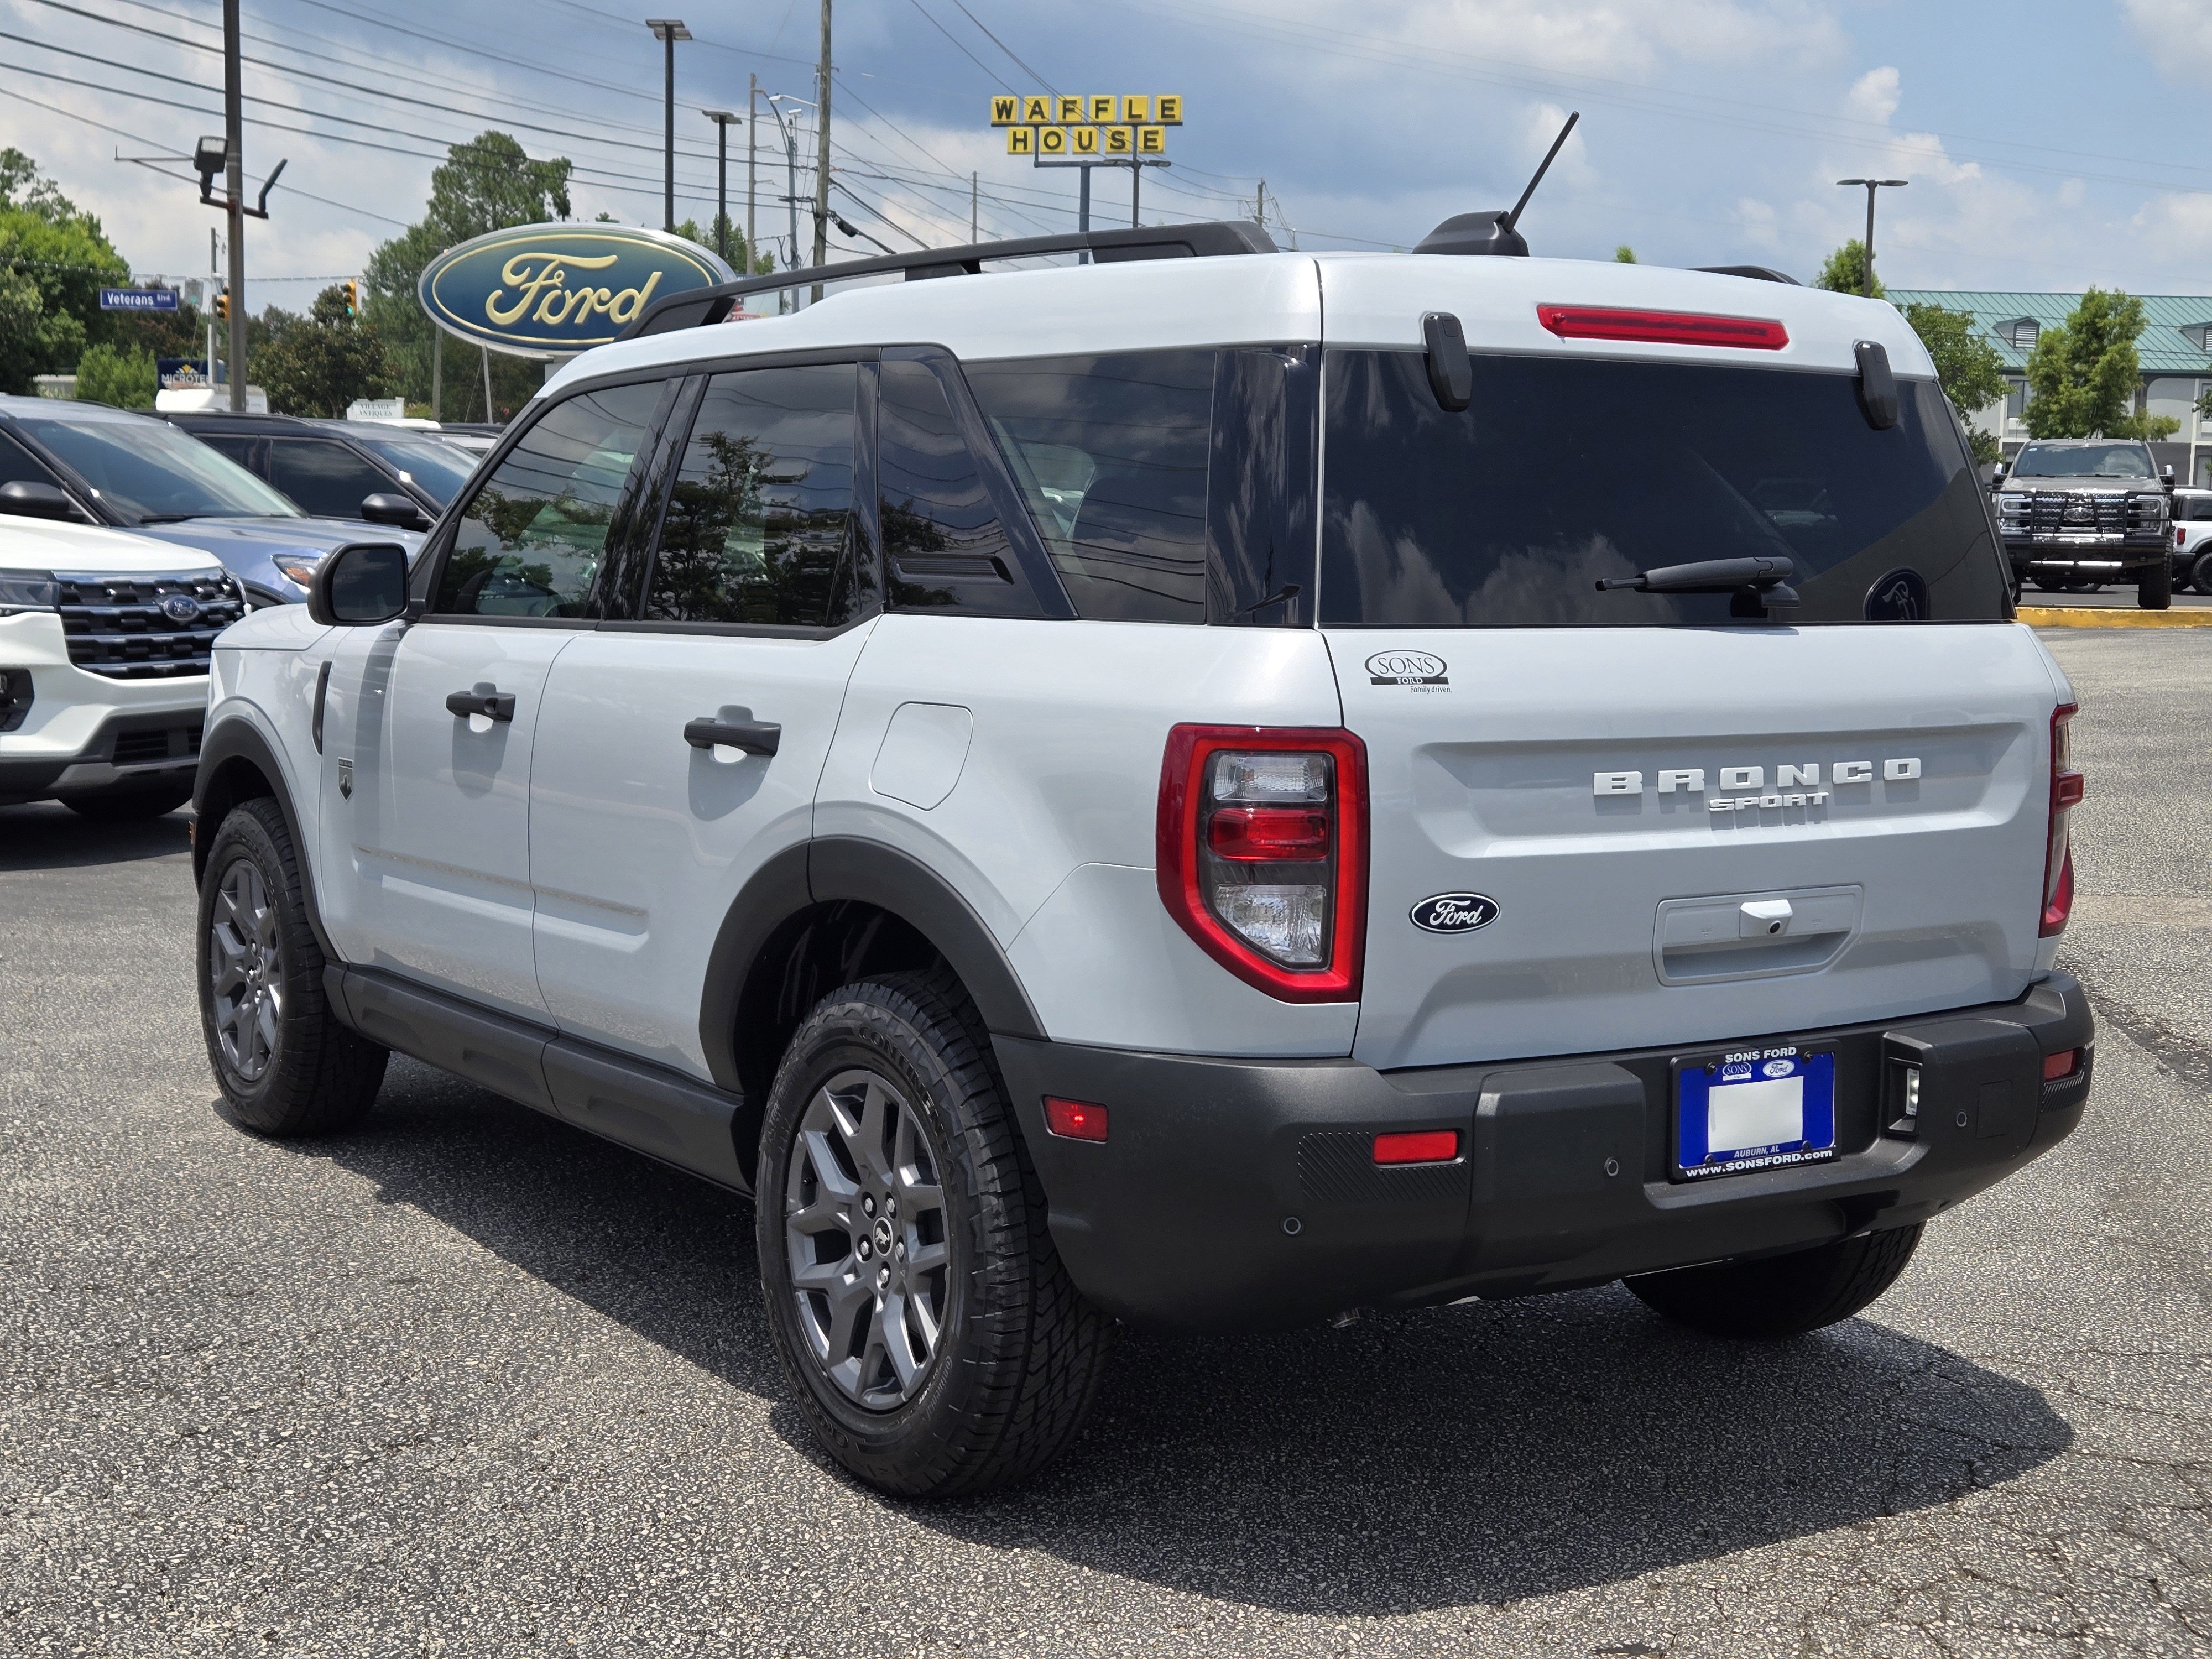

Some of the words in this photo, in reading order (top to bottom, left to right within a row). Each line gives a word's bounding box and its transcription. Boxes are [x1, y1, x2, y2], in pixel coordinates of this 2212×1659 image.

[995, 98, 1176, 119] WAFFLE
[1012, 129, 1159, 151] HOUSE
[486, 252, 662, 325] Ford
[107, 292, 154, 305] Veterans
[1378, 657, 1435, 674] SONS
[1410, 686, 1430, 695] Family
[1593, 758, 1922, 795] BRONCO
[1709, 792, 1829, 812] SPORT
[1430, 900, 1484, 926] Ford
[1725, 1051, 1760, 1063] SONS
[1764, 1047, 1797, 1059] FORD
[1726, 1064, 1747, 1074] SONS
[1770, 1062, 1788, 1074] Ford
[1734, 1147, 1768, 1159] AUBURN,
[1686, 1150, 1833, 1177] www.SONSFORD.com
